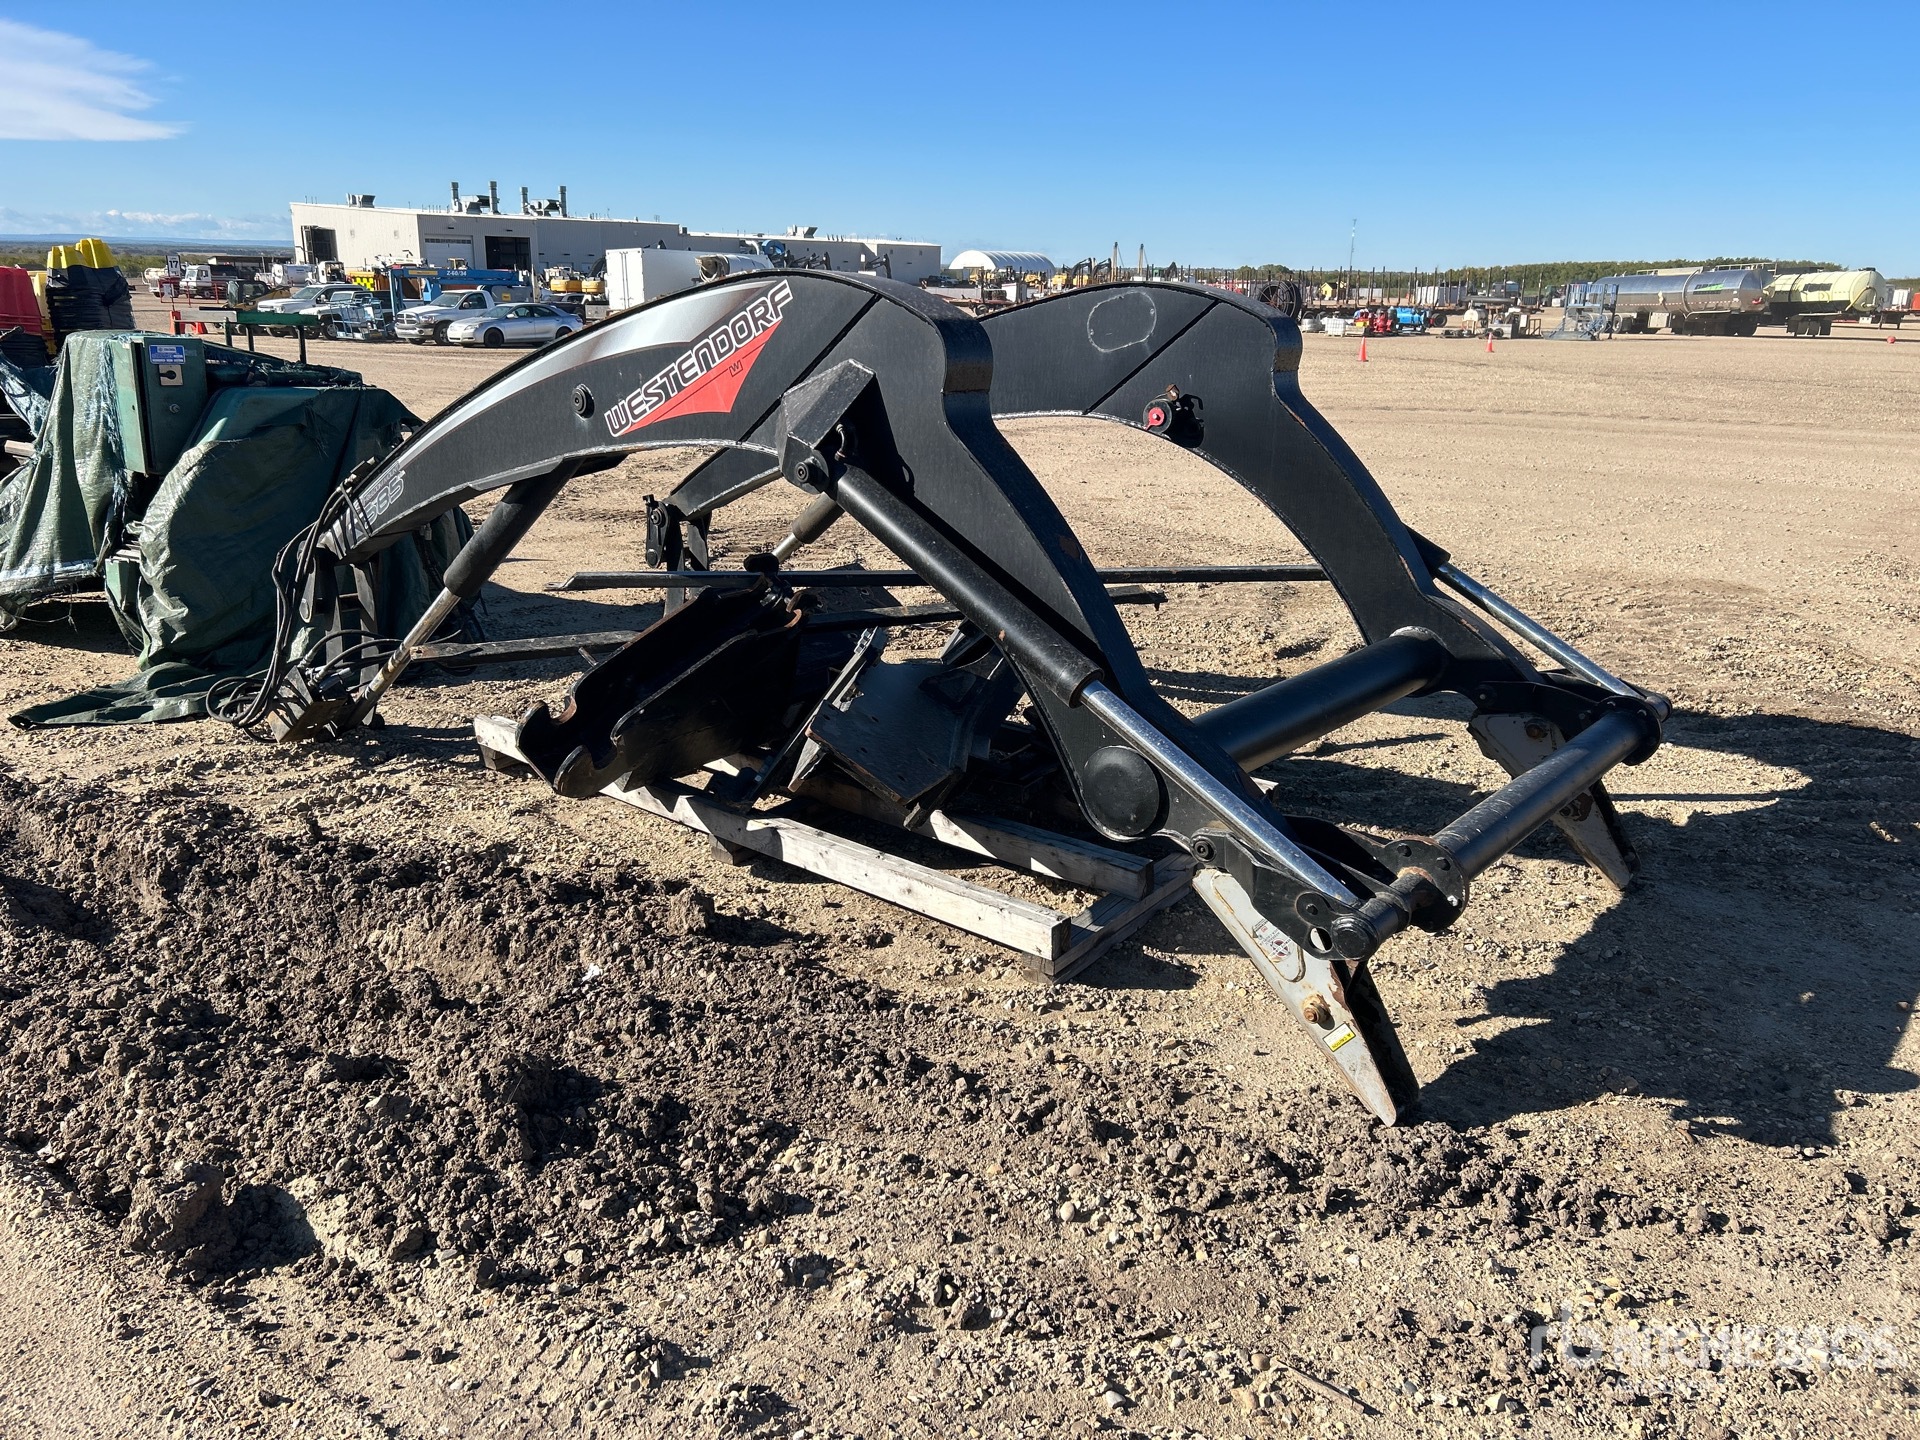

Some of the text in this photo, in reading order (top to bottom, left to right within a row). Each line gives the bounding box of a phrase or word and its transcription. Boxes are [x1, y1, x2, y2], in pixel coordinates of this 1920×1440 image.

[168, 260, 178, 268] 17
[604, 279, 794, 438] WESTENDORF
[362, 475, 404, 529] 585
